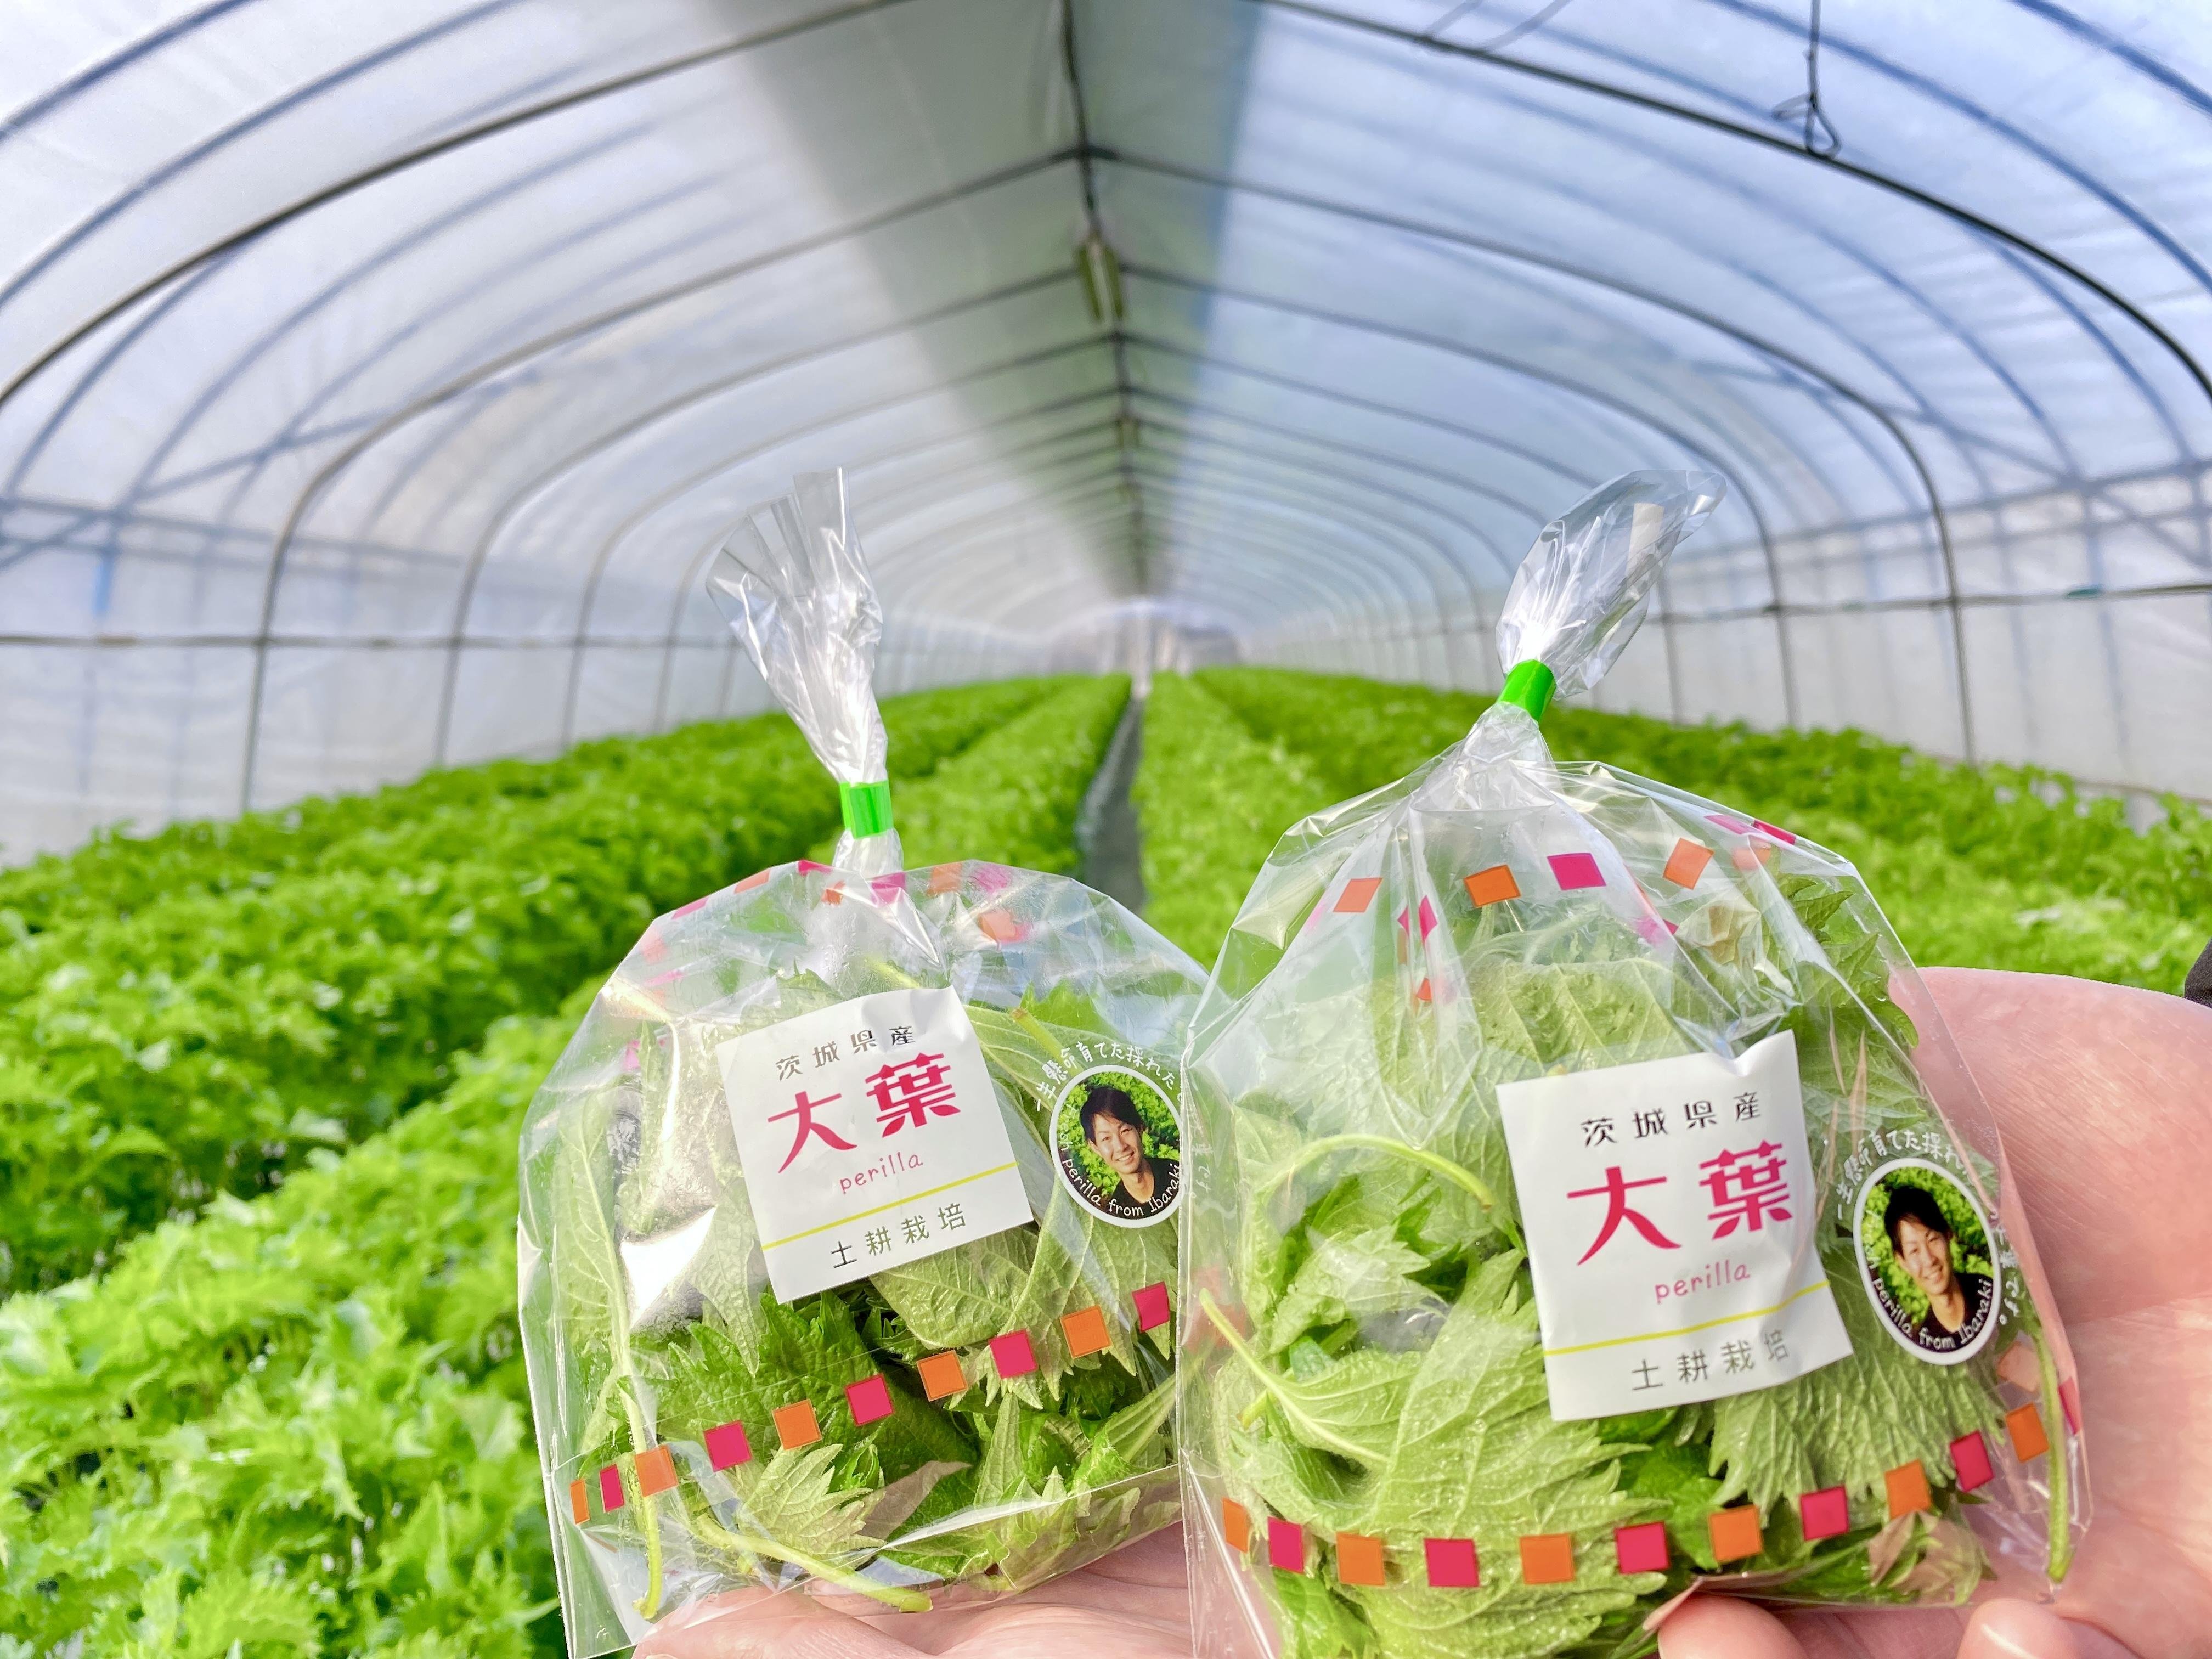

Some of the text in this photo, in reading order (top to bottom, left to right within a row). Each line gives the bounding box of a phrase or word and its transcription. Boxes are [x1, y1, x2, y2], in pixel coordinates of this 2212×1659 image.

[776, 1026, 915, 1081] 茨城県産
[768, 1052, 961, 1173] 大葉
[1581, 1092, 1761, 1148] 茨城県産
[839, 1152, 923, 1194] perilla
[1062, 1158, 1101, 1206] perilla
[1109, 1200, 1144, 1217] from
[1150, 1163, 1181, 1213] Ibaraki
[1567, 1139, 1793, 1266] 大葉
[831, 1203, 966, 1268] 土耕栽培
[1656, 1260, 1750, 1304] perilla
[1871, 1278, 1912, 1333] perilla
[1919, 1329, 1956, 1350] from
[1959, 1278, 1994, 1345] Ibaraki
[1632, 1329, 1790, 1391] 土耕栽培
